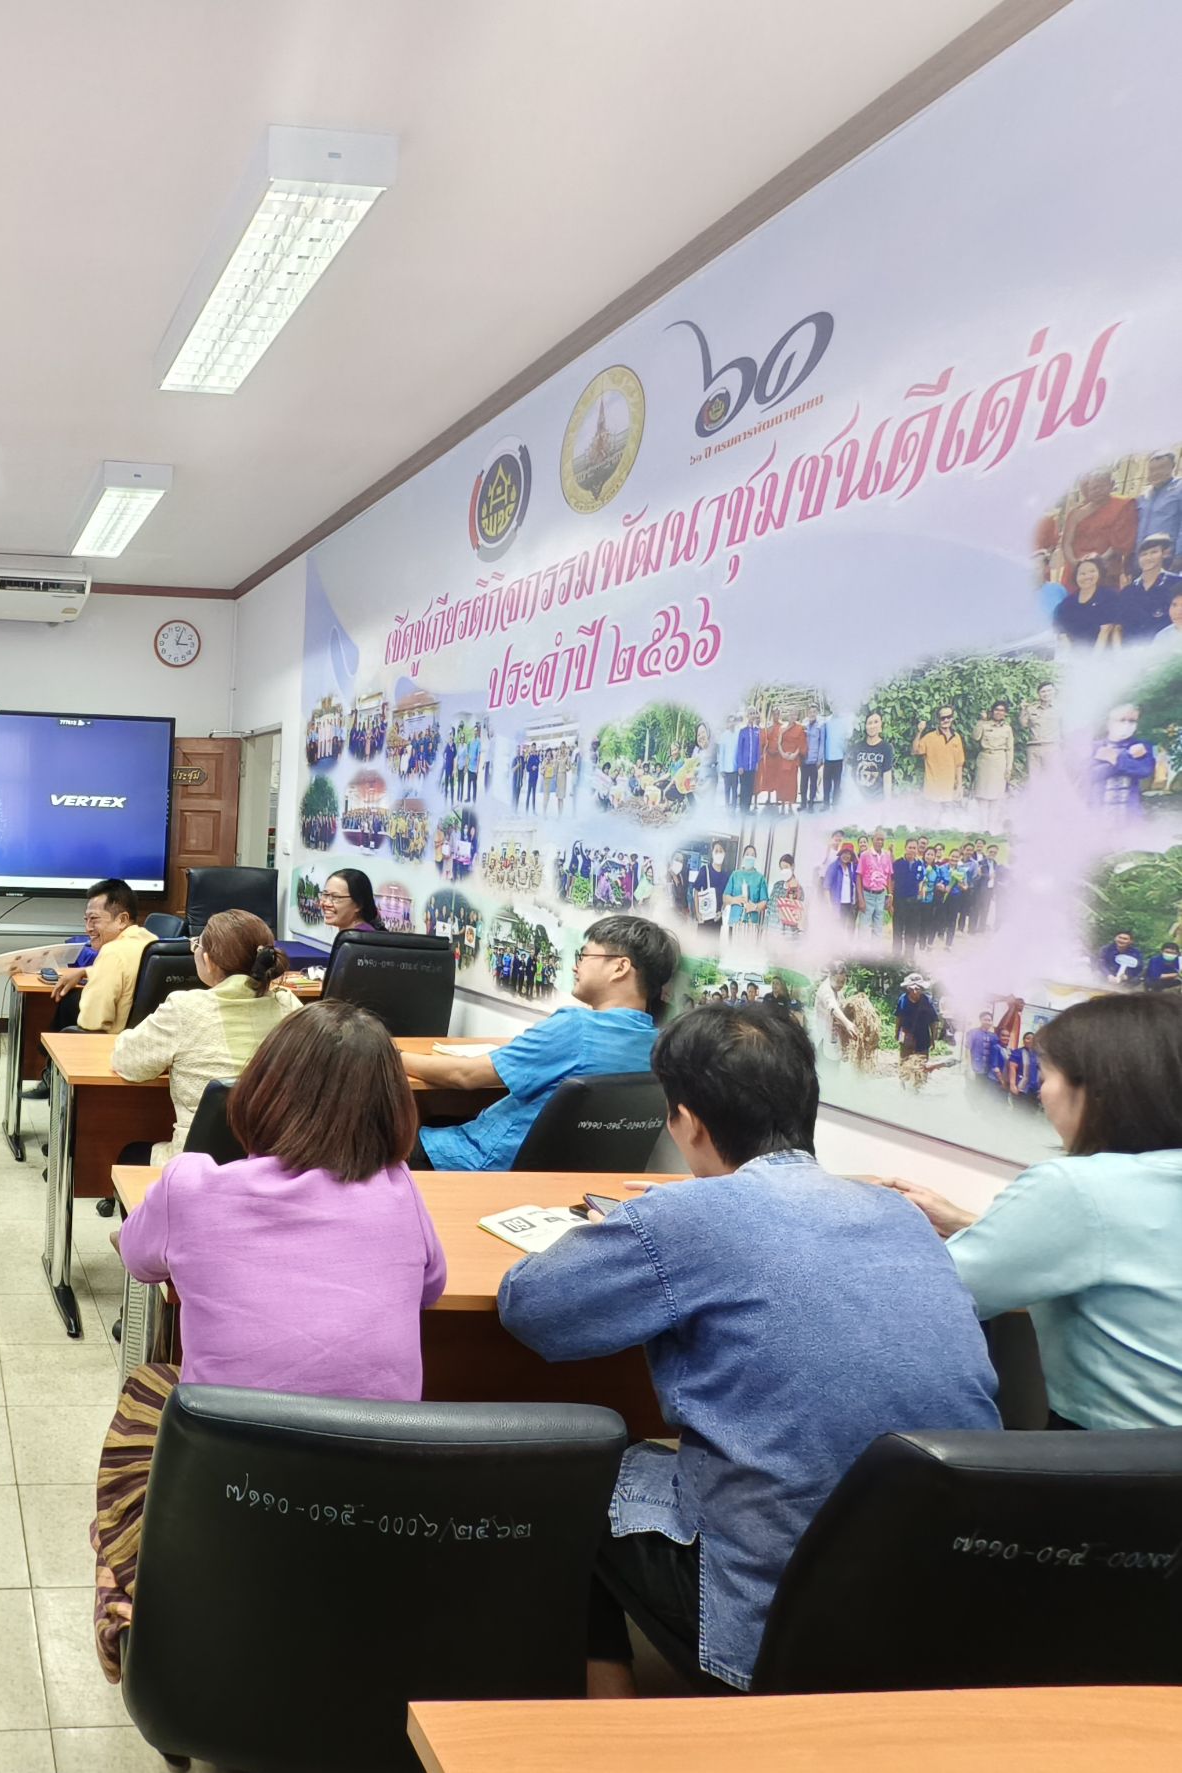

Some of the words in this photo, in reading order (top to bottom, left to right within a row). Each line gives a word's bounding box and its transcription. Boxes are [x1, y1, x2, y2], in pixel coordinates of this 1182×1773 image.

[489, 614, 607, 709] ประจำปี
[608, 597, 721, 684] ๒๕๖๖
[857, 751, 884, 763] GUCCI
[50, 794, 127, 808] VERTEX
